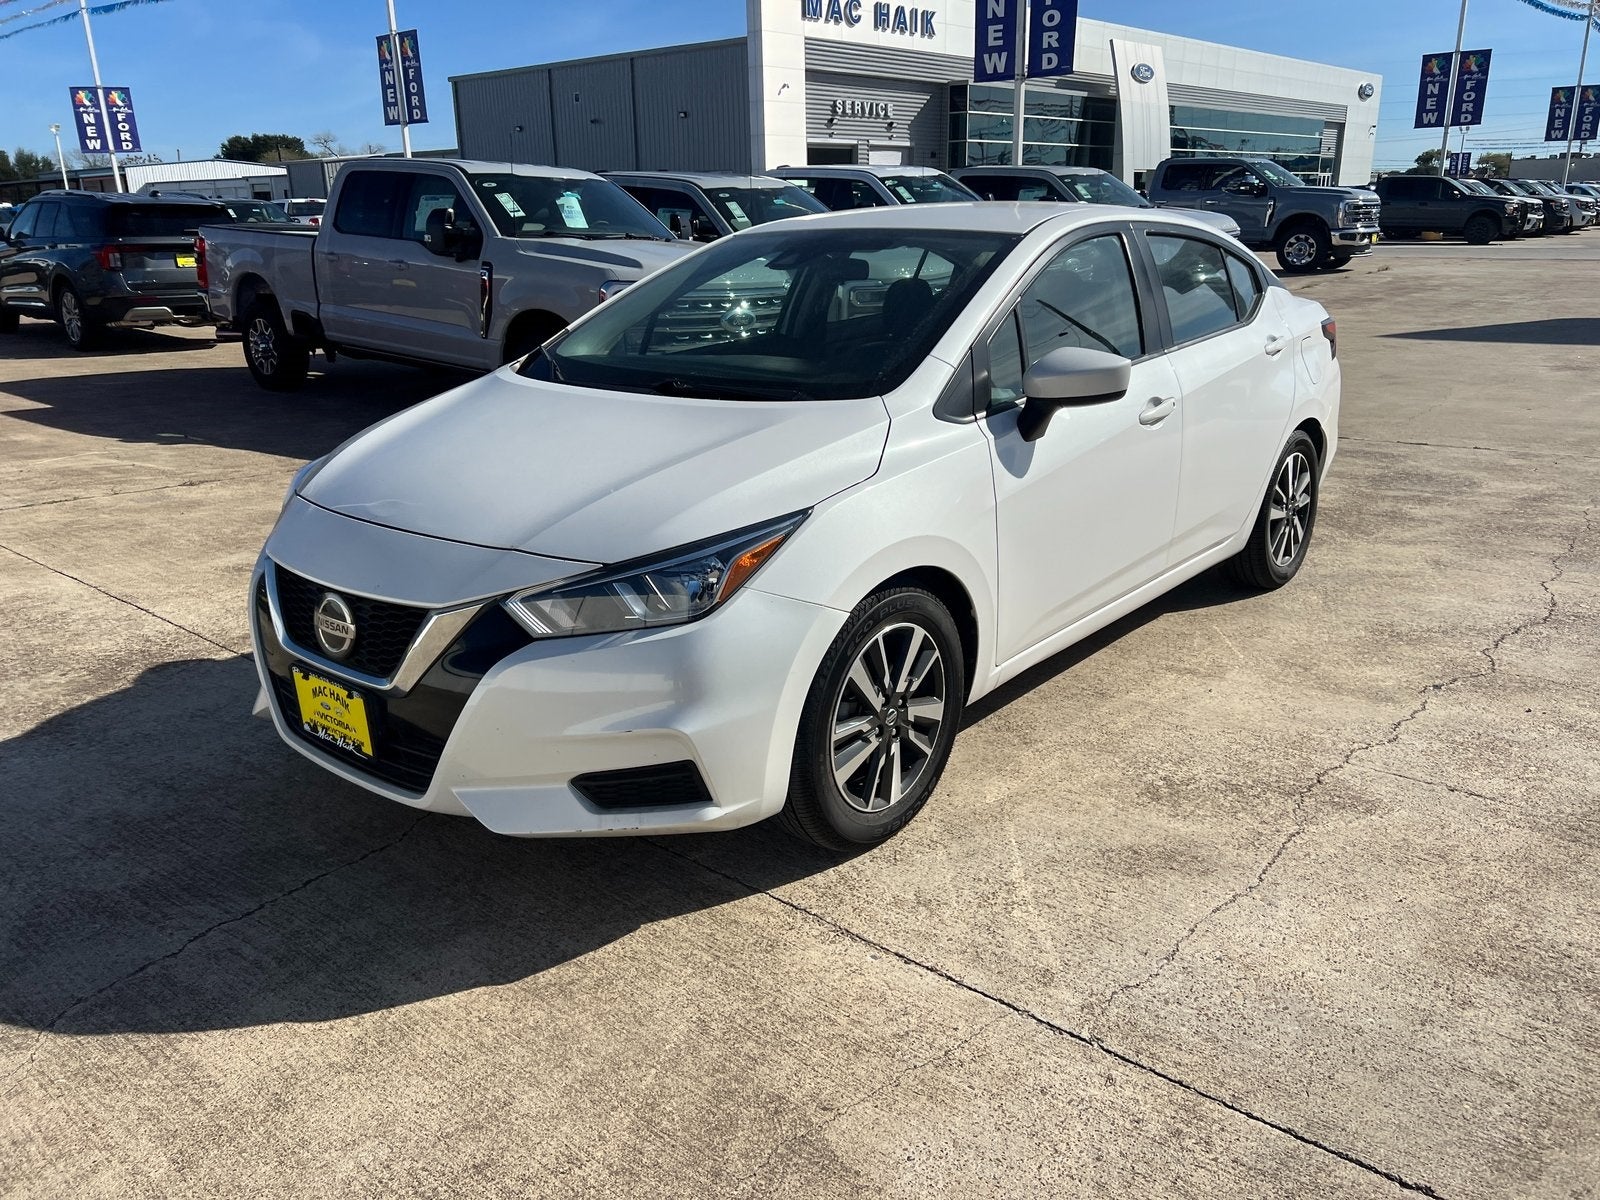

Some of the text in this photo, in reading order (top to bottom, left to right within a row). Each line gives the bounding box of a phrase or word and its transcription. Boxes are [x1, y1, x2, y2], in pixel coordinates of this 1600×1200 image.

[803, 0, 936, 37] MAC HAIK
[983, 0, 1008, 74] NEW
[1042, 0, 1061, 70] ORD
[385, 71, 398, 120] NEW
[408, 69, 421, 120] FORD
[836, 99, 894, 117] SERVICE
[1422, 83, 1440, 124] NEW
[1460, 81, 1476, 123] FORD
[82, 113, 101, 150] NEW
[117, 113, 133, 150] FORD
[1551, 108, 1565, 139] NEW
[1580, 107, 1593, 138] FORD
[320, 618, 349, 635] NISSAN
[311, 685, 350, 714] MAC HAIK
